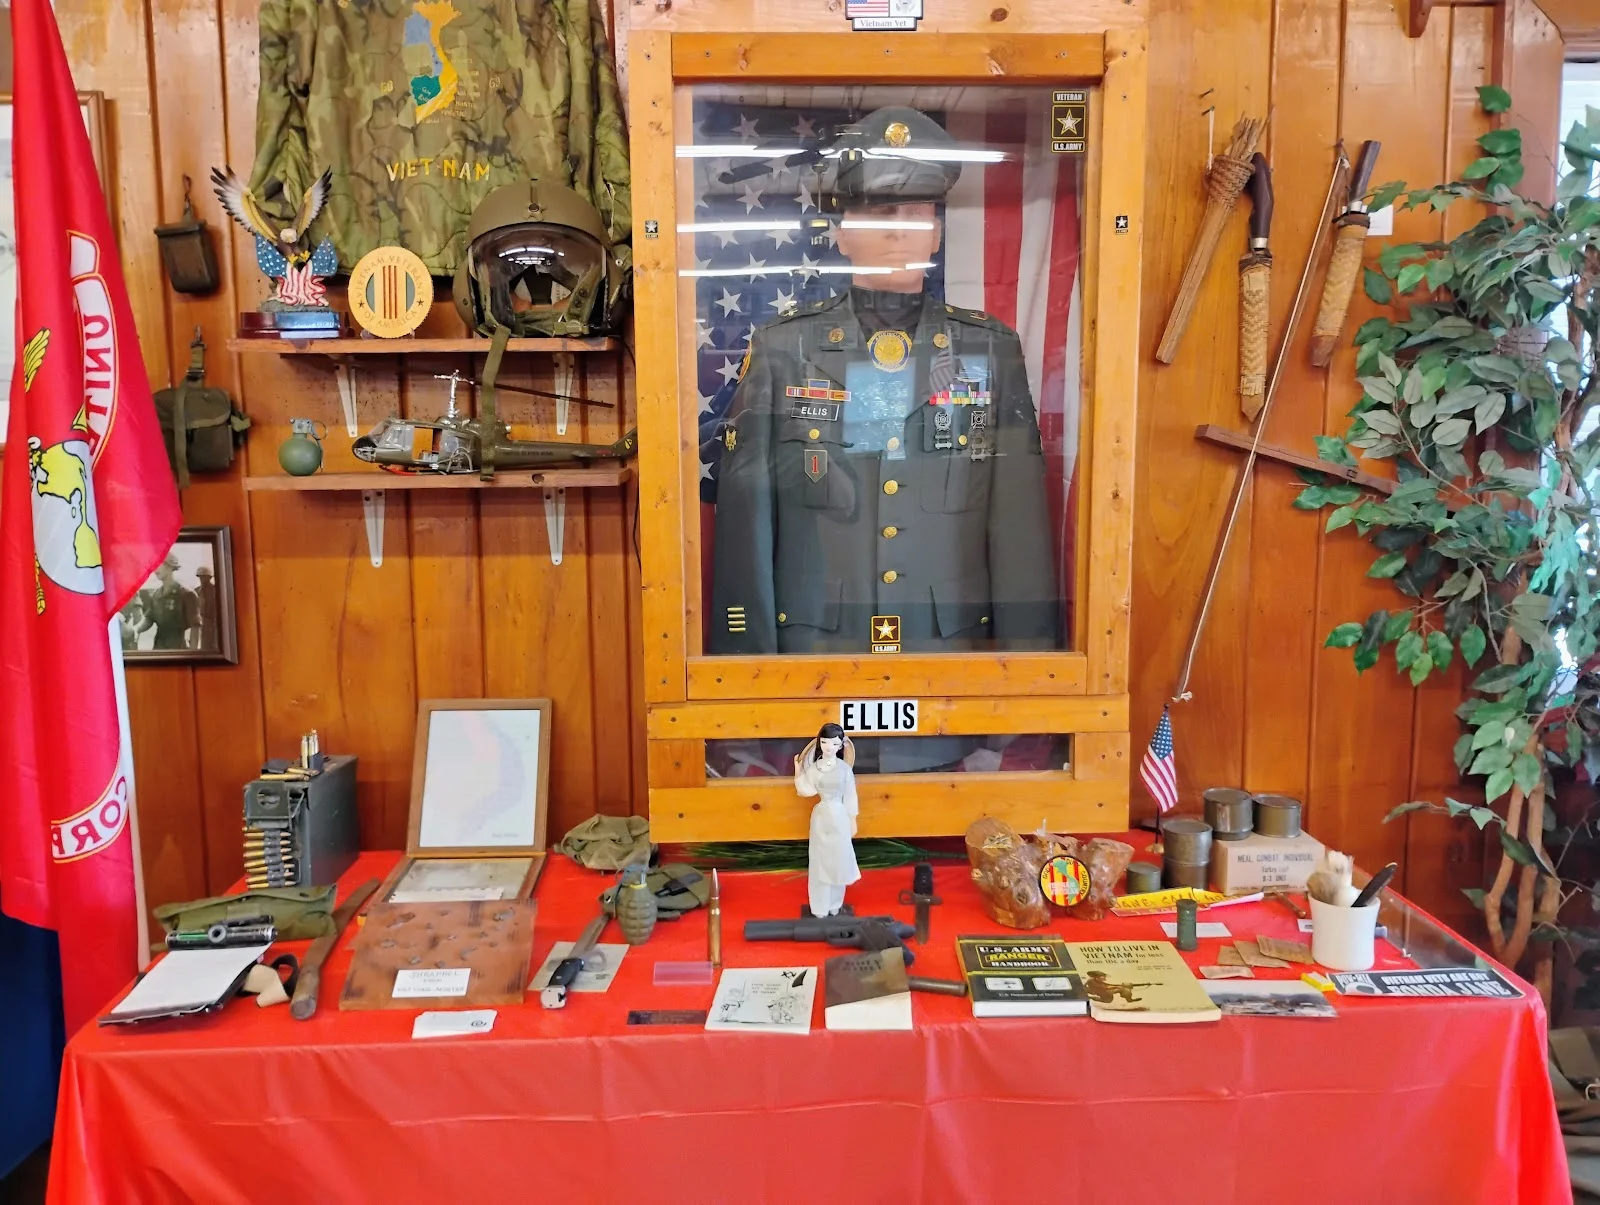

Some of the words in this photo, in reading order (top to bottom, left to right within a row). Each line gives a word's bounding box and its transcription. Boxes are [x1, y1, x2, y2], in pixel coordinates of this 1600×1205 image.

[860, 19, 892, 27] Vietnam
[894, 19, 907, 27] Vet
[1056, 93, 1083, 101] VETERAN
[356, 256, 385, 298] VIETNAM
[389, 255, 424, 296] VETERANS
[364, 310, 376, 323] OF
[377, 310, 417, 328] AMERICA
[801, 406, 828, 416] ELLIS
[843, 702, 915, 731] ELLIS
[1011, 945, 1051, 953] ARMY
[989, 952, 1047, 961] RANGER
[1381, 974, 1426, 985] VIETNAM
[1424, 973, 1450, 983] VETS
[1449, 972, 1471, 981] ARE
[1386, 982, 1461, 997] FONDA
[1455, 980, 1512, 996] JANE
